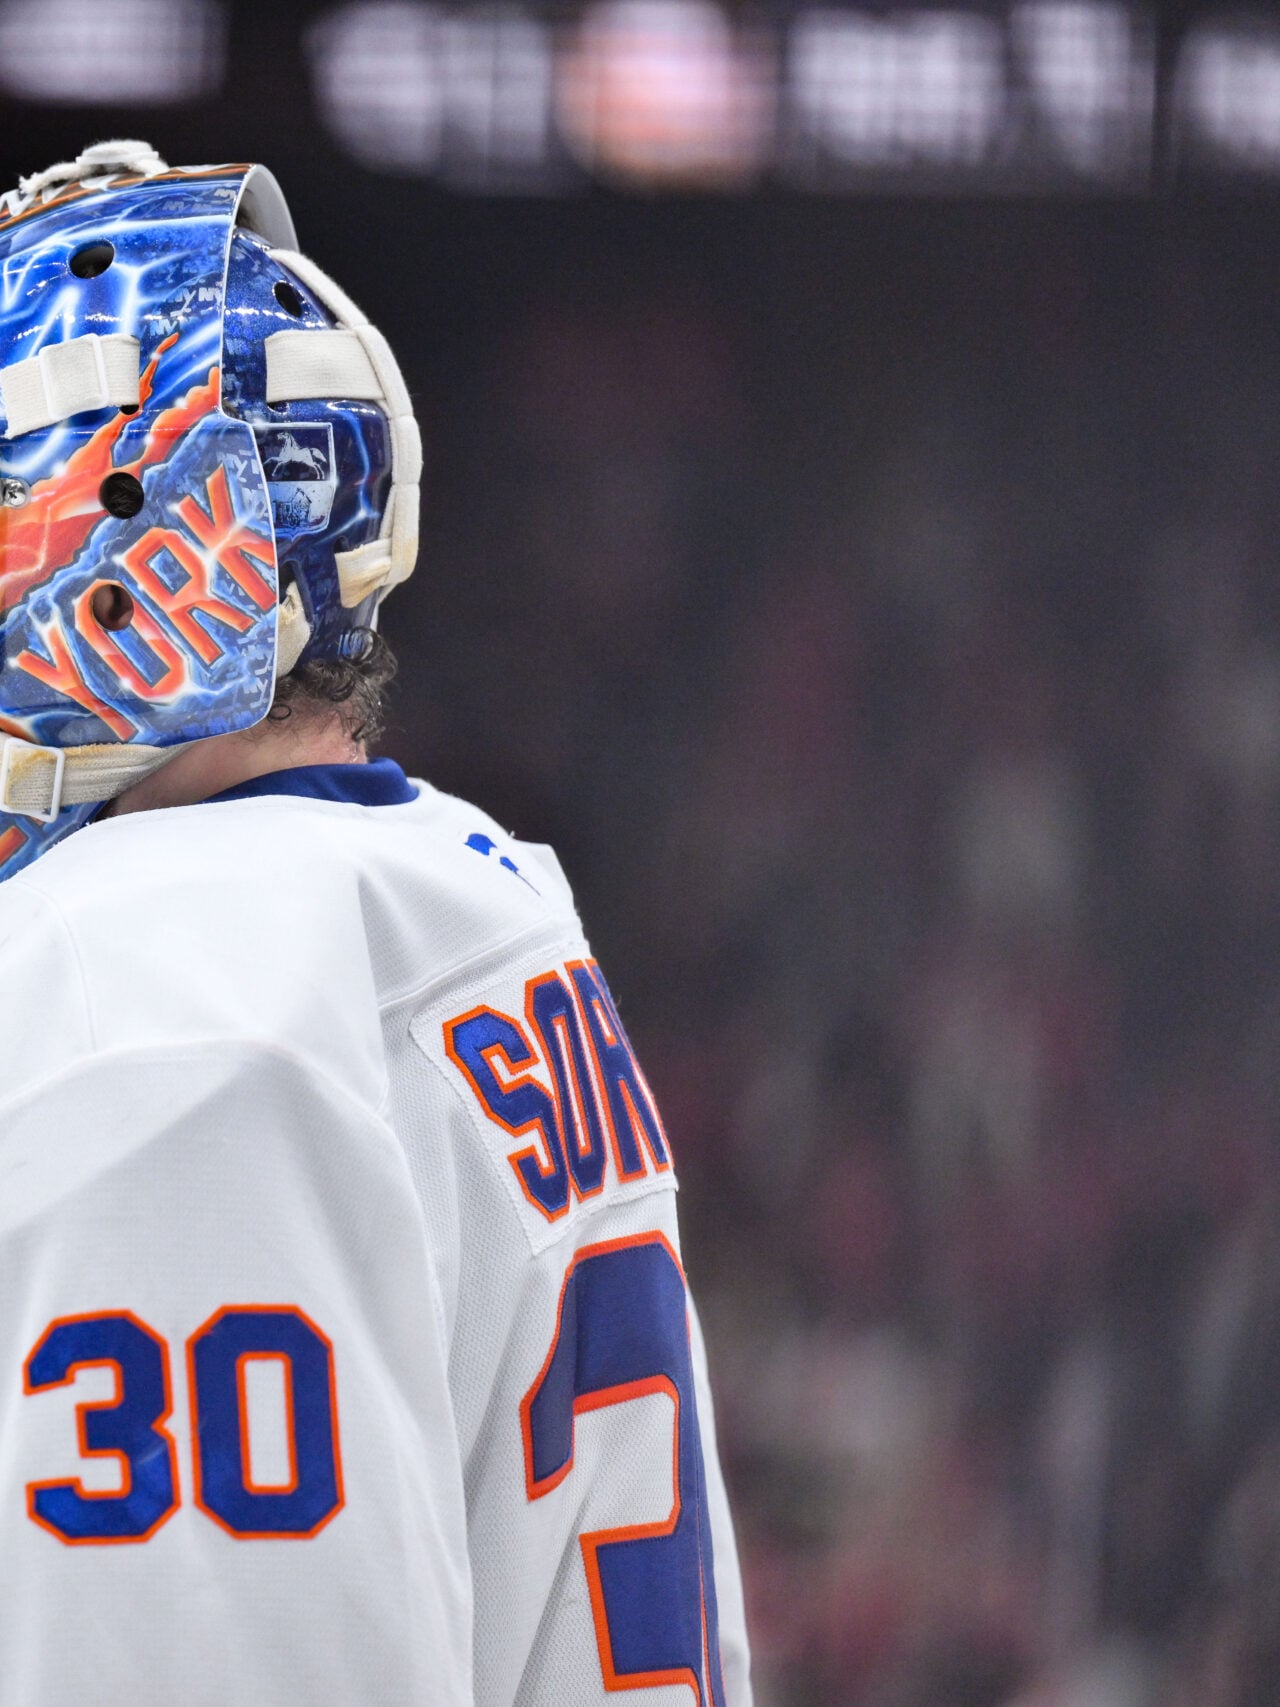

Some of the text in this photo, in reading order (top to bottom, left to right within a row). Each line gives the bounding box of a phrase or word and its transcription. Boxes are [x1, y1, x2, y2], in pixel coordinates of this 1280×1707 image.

[16, 463, 277, 742] YORK
[442, 957, 673, 1223] SOR
[23, 1304, 346, 1546] 30
[520, 1230, 727, 1707] 3
